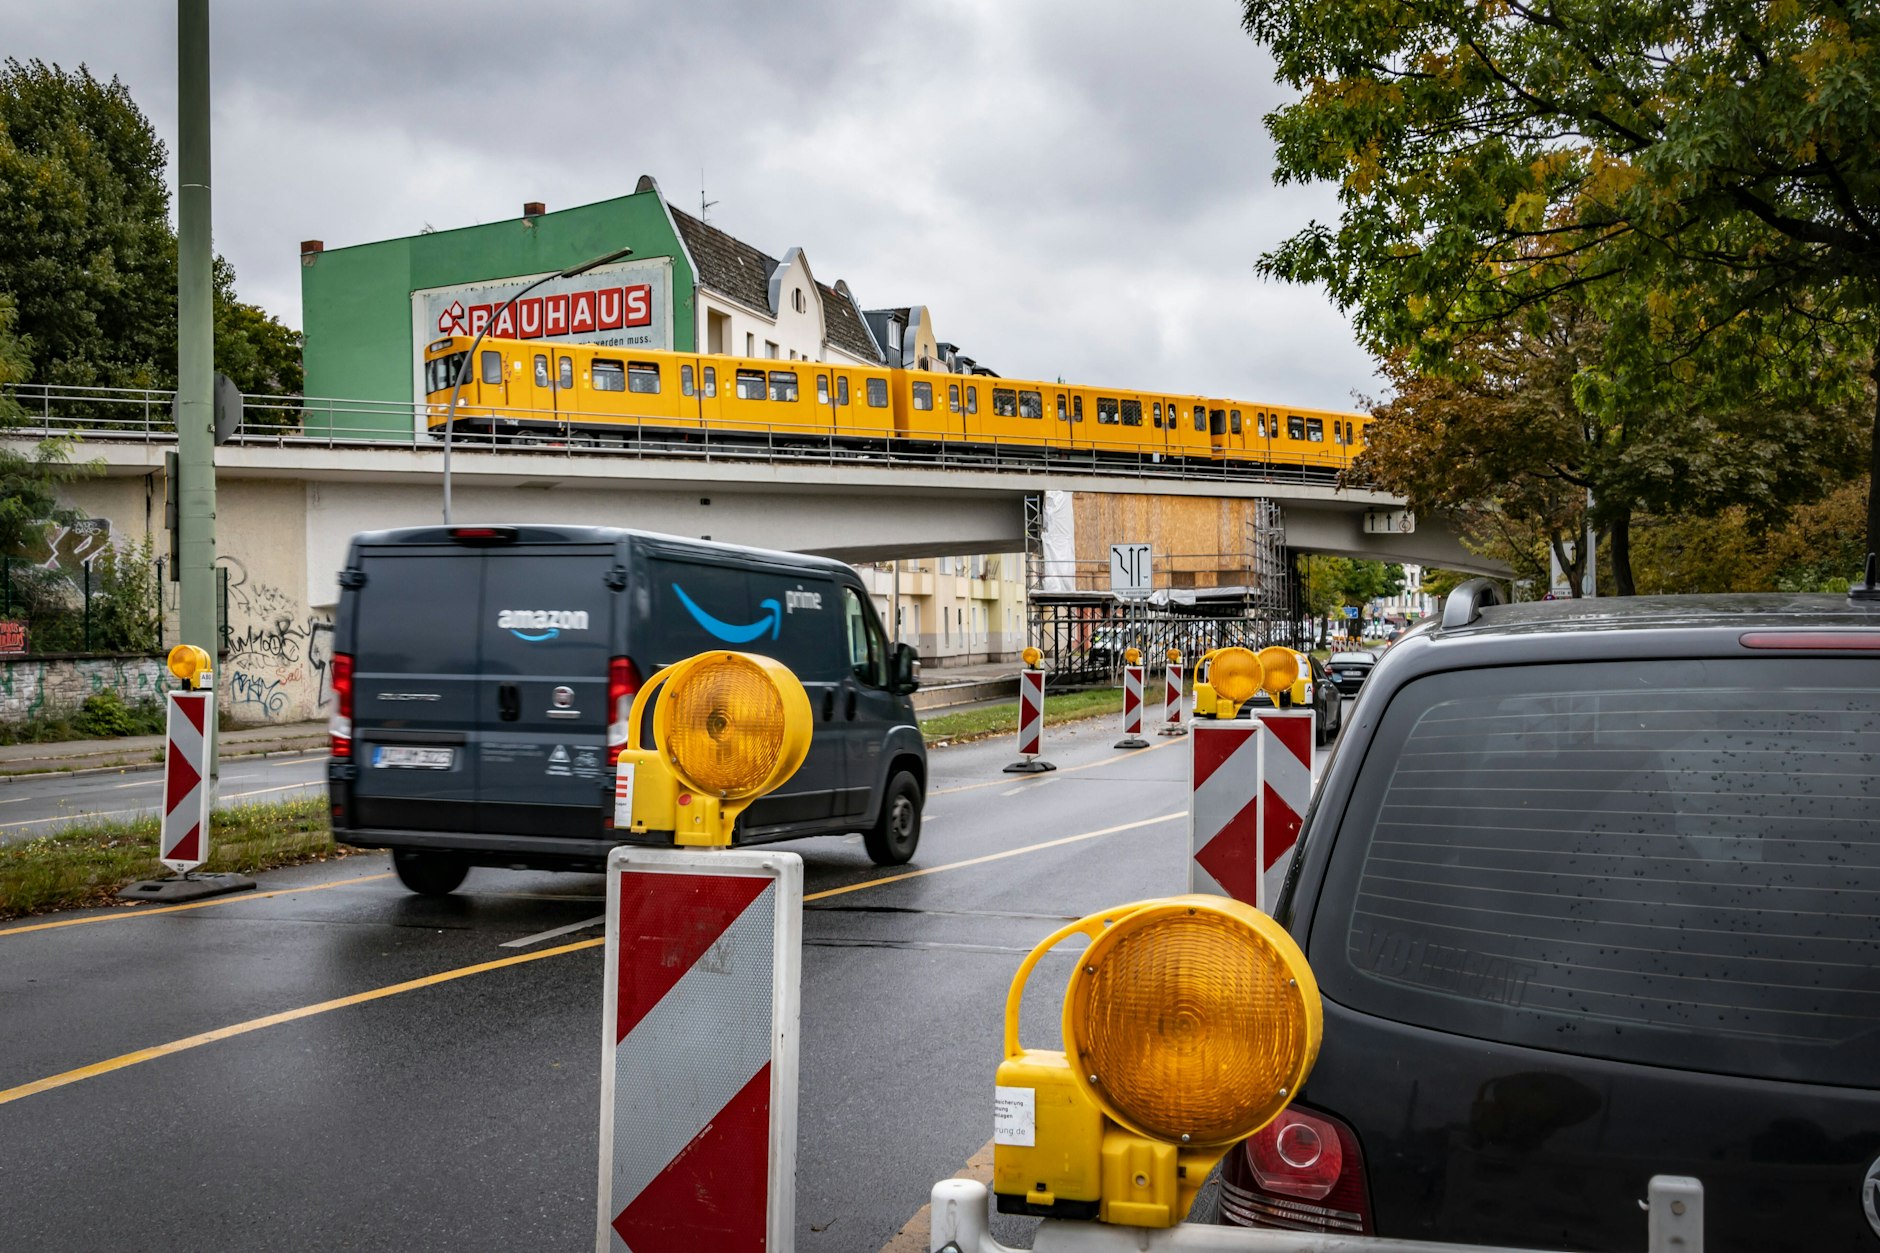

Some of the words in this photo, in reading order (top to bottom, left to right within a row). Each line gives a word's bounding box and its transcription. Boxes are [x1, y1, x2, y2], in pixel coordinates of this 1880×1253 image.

[472, 290, 647, 337] BAUHAUS
[627, 335, 652, 344] muss.
[785, 584, 822, 614] prime
[498, 609, 589, 630] amazon
